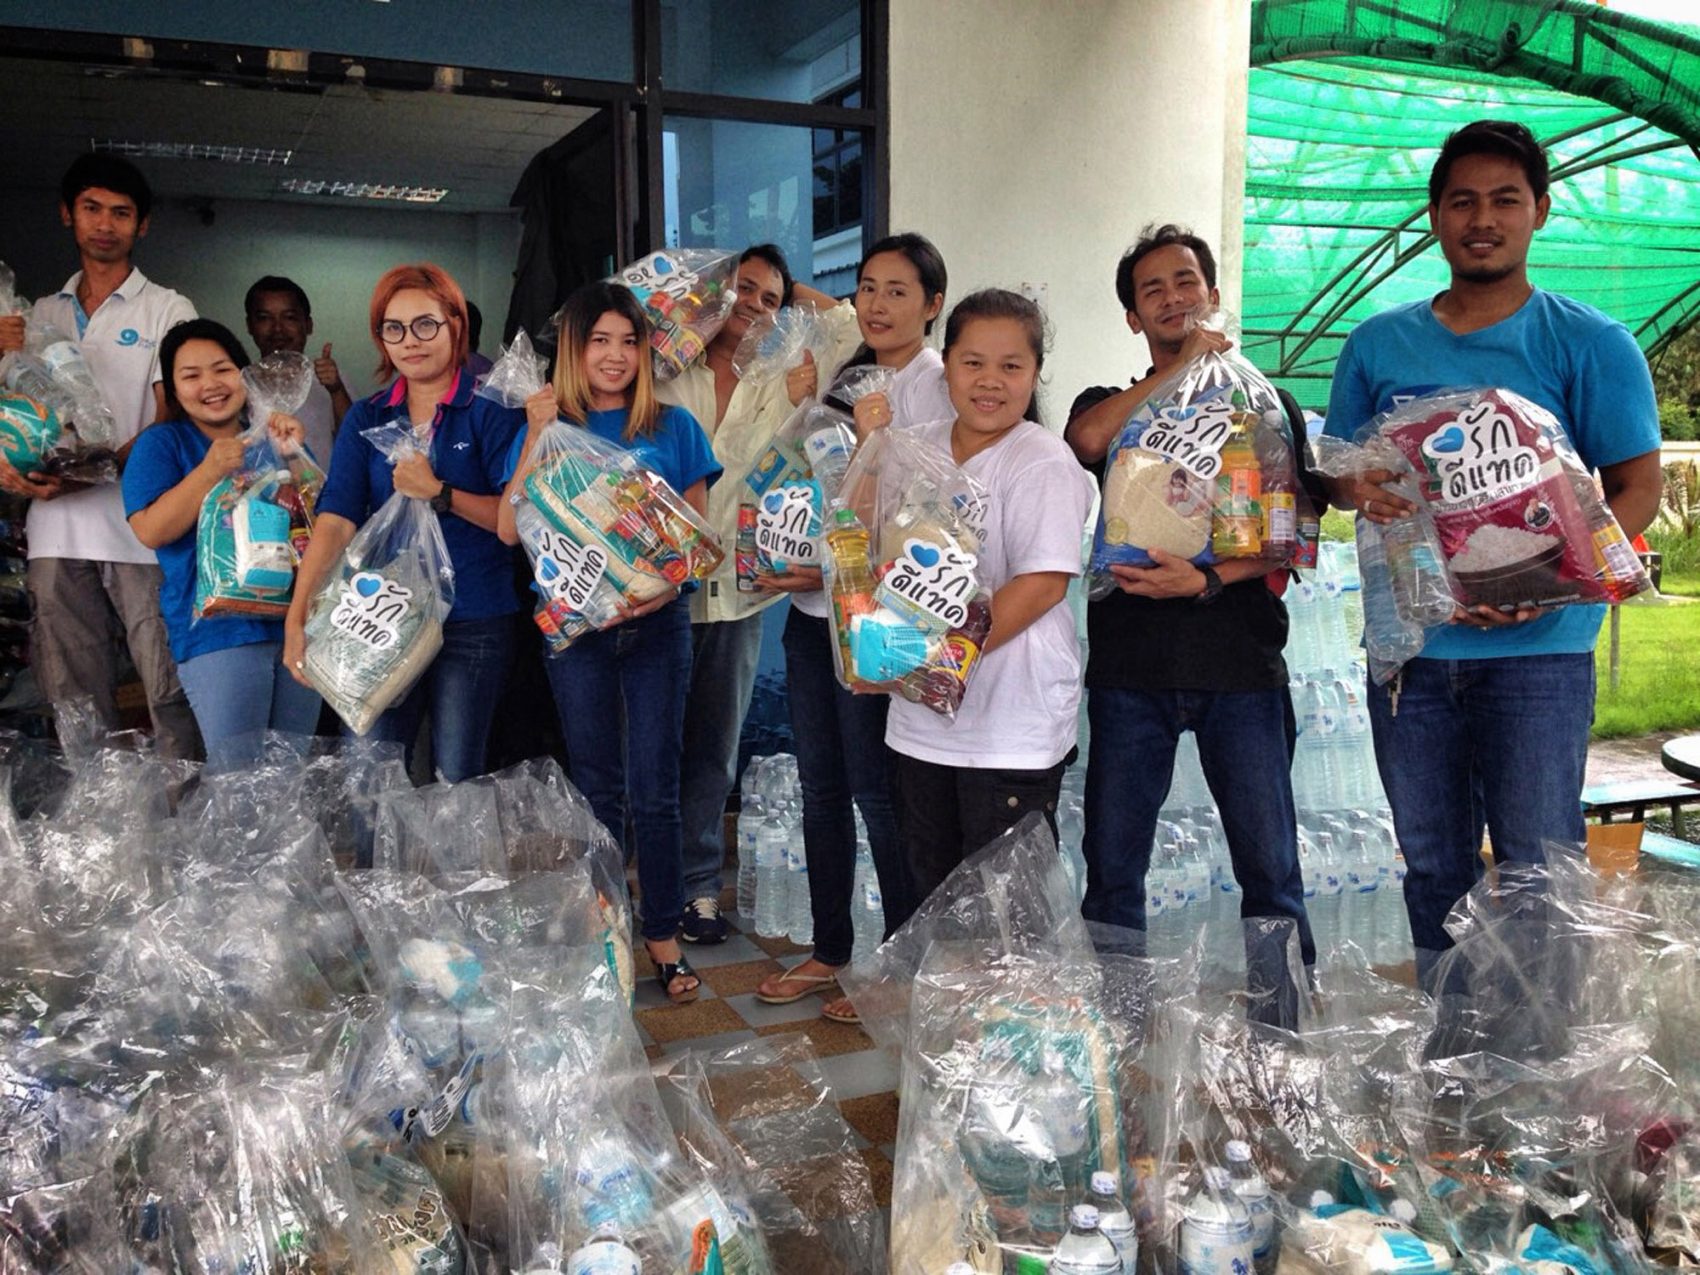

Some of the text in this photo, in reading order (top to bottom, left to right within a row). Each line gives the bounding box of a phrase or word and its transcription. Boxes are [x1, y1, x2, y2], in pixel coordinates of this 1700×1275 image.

[1185, 405, 1229, 444] รัก
[1466, 407, 1512, 458] รัก
[1146, 422, 1216, 476] ดีแทค
[1445, 452, 1534, 498] ดีแทค
[779, 491, 809, 534] รัก
[543, 532, 580, 572] รัก
[760, 519, 812, 557] ดีแทค
[561, 549, 604, 604] ดีแทค
[891, 564, 964, 624] ดีแทค
[929, 553, 970, 597] รัก
[337, 597, 392, 646] ดีแทค
[366, 584, 409, 623] รัก
